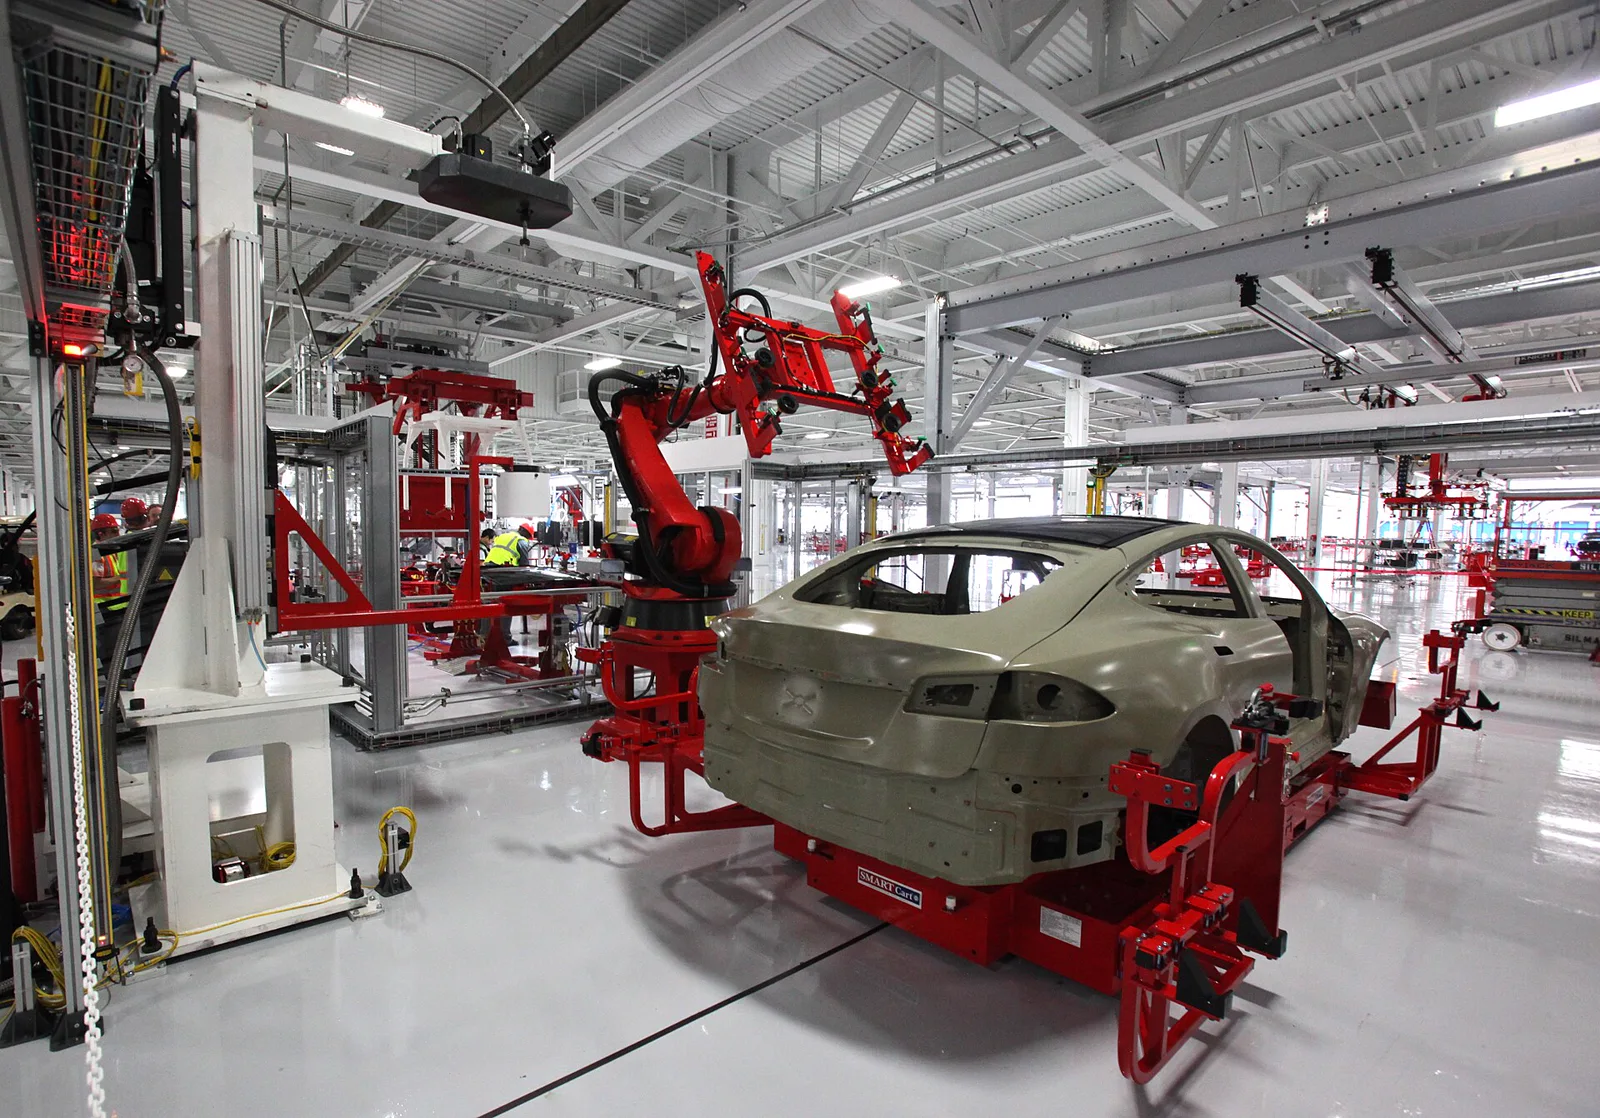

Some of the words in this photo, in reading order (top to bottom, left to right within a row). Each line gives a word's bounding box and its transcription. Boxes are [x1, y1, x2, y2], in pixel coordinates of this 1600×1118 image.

[1580, 563, 1600, 571] SIL
[1564, 610, 1591, 619] KEEP
[860, 871, 895, 892] SMART
[895, 886, 913, 901] Cart
